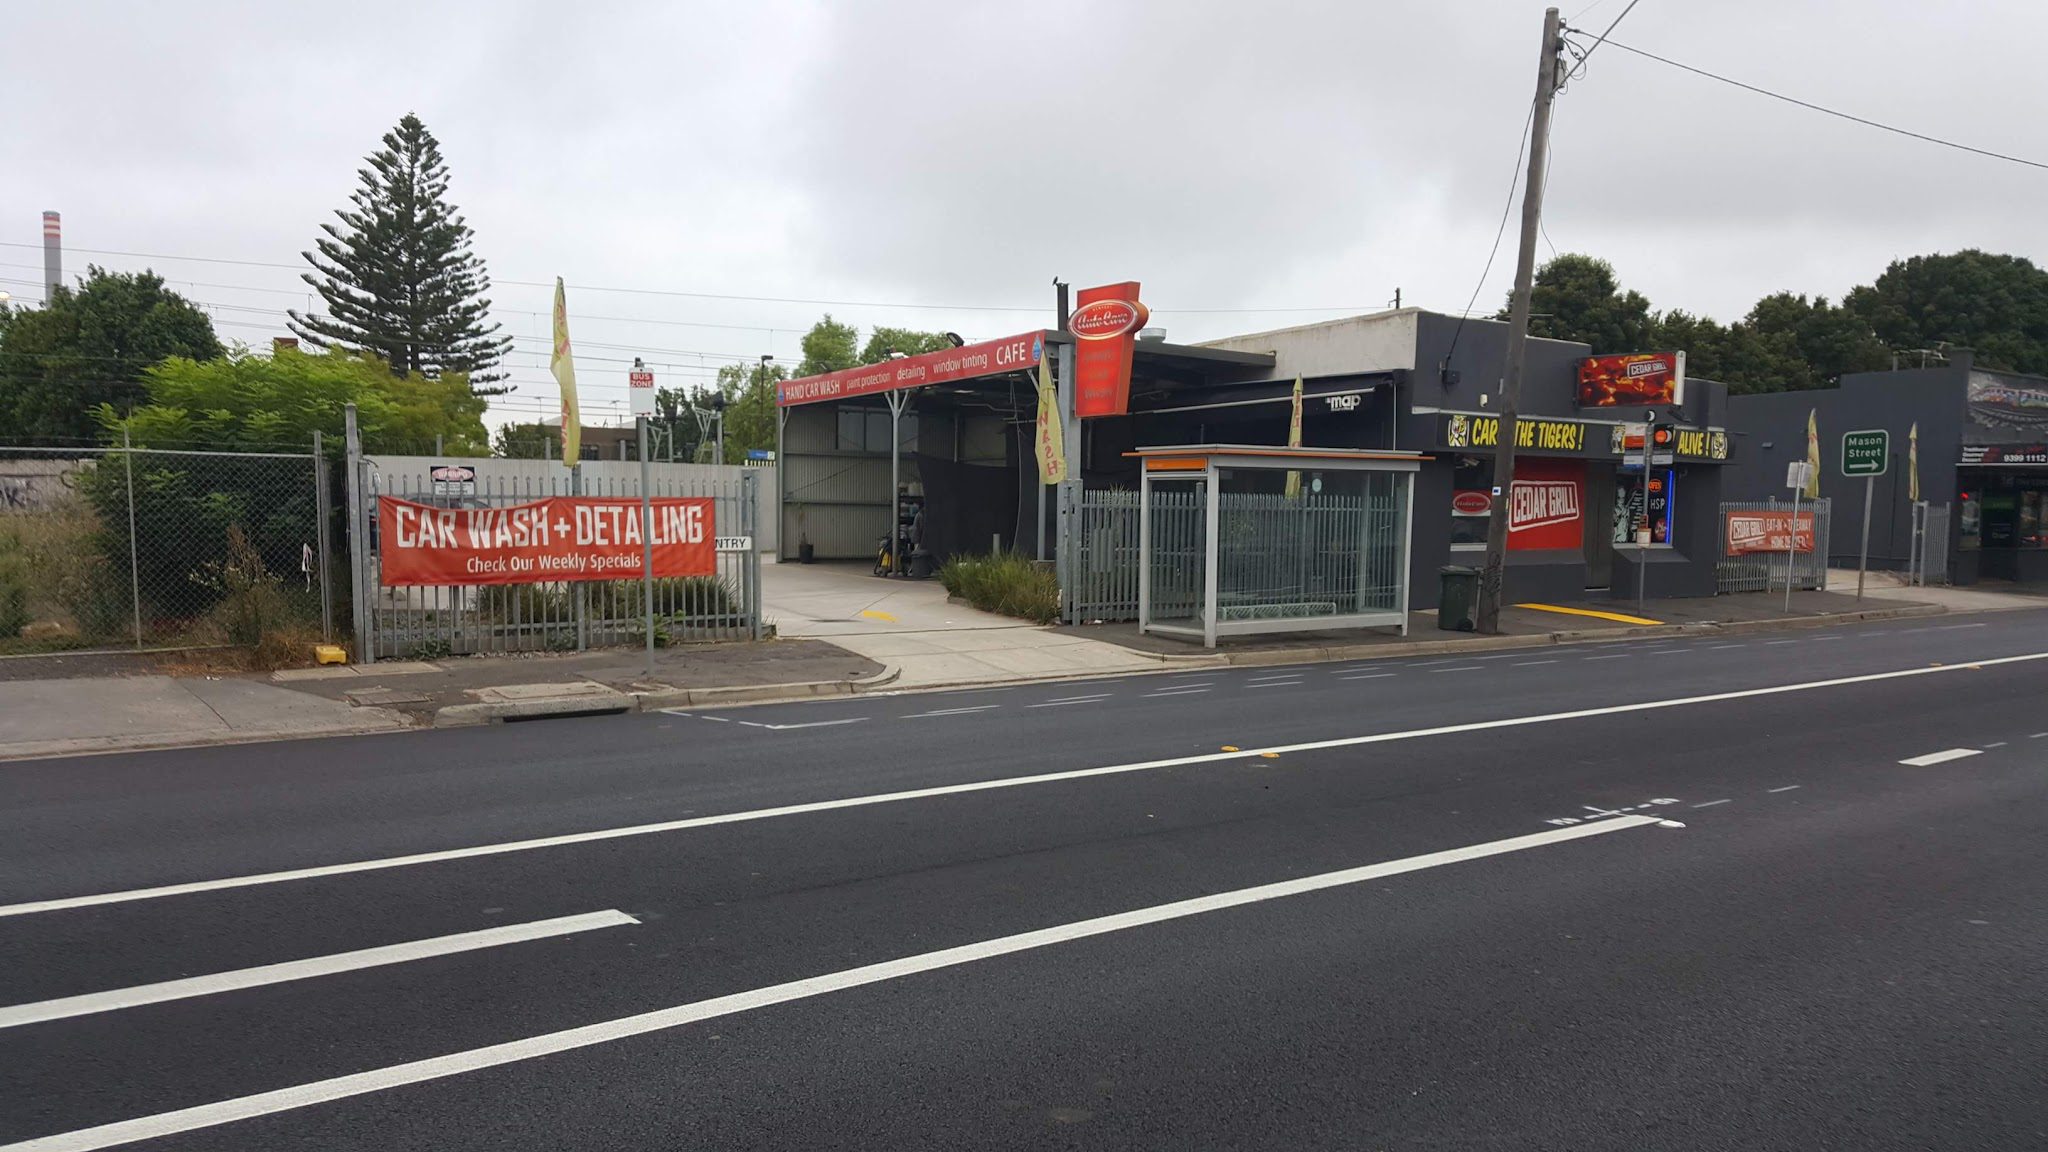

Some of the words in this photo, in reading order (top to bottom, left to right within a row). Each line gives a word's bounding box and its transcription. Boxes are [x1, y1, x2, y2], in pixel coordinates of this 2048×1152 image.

[785, 385, 804, 400] HAND
[805, 383, 819, 398] CAR
[820, 380, 840, 395] WASH
[846, 377, 860, 391] paint
[861, 372, 891, 389] protection
[896, 365, 926, 380] detailing
[933, 357, 961, 373] window
[962, 353, 988, 368] tinting
[996, 342, 1026, 365] CAFE
[1630, 363, 1651, 376] CEDAR
[1652, 360, 1667, 372] GRILL
[631, 380, 653, 388] ZONE
[1330, 394, 1362, 411] map
[1472, 417, 1499, 446] CAR
[1514, 420, 1536, 447] THE
[1848, 437, 1882, 446] Mason
[1848, 447, 1882, 458] Street
[2003, 454, 2025, 462] 9399
[2026, 453, 2047, 462] 1112
[1513, 486, 1547, 524] CEDAR
[1548, 486, 1577, 517] GRILL
[1650, 498, 1666, 510] HSP
[396, 505, 458, 549] CAR
[715, 538, 747, 549] NTRY
[466, 555, 506, 573] Check
[510, 556, 535, 572] Our
[539, 554, 587, 572] Weekly
[591, 553, 641, 572] Specials
